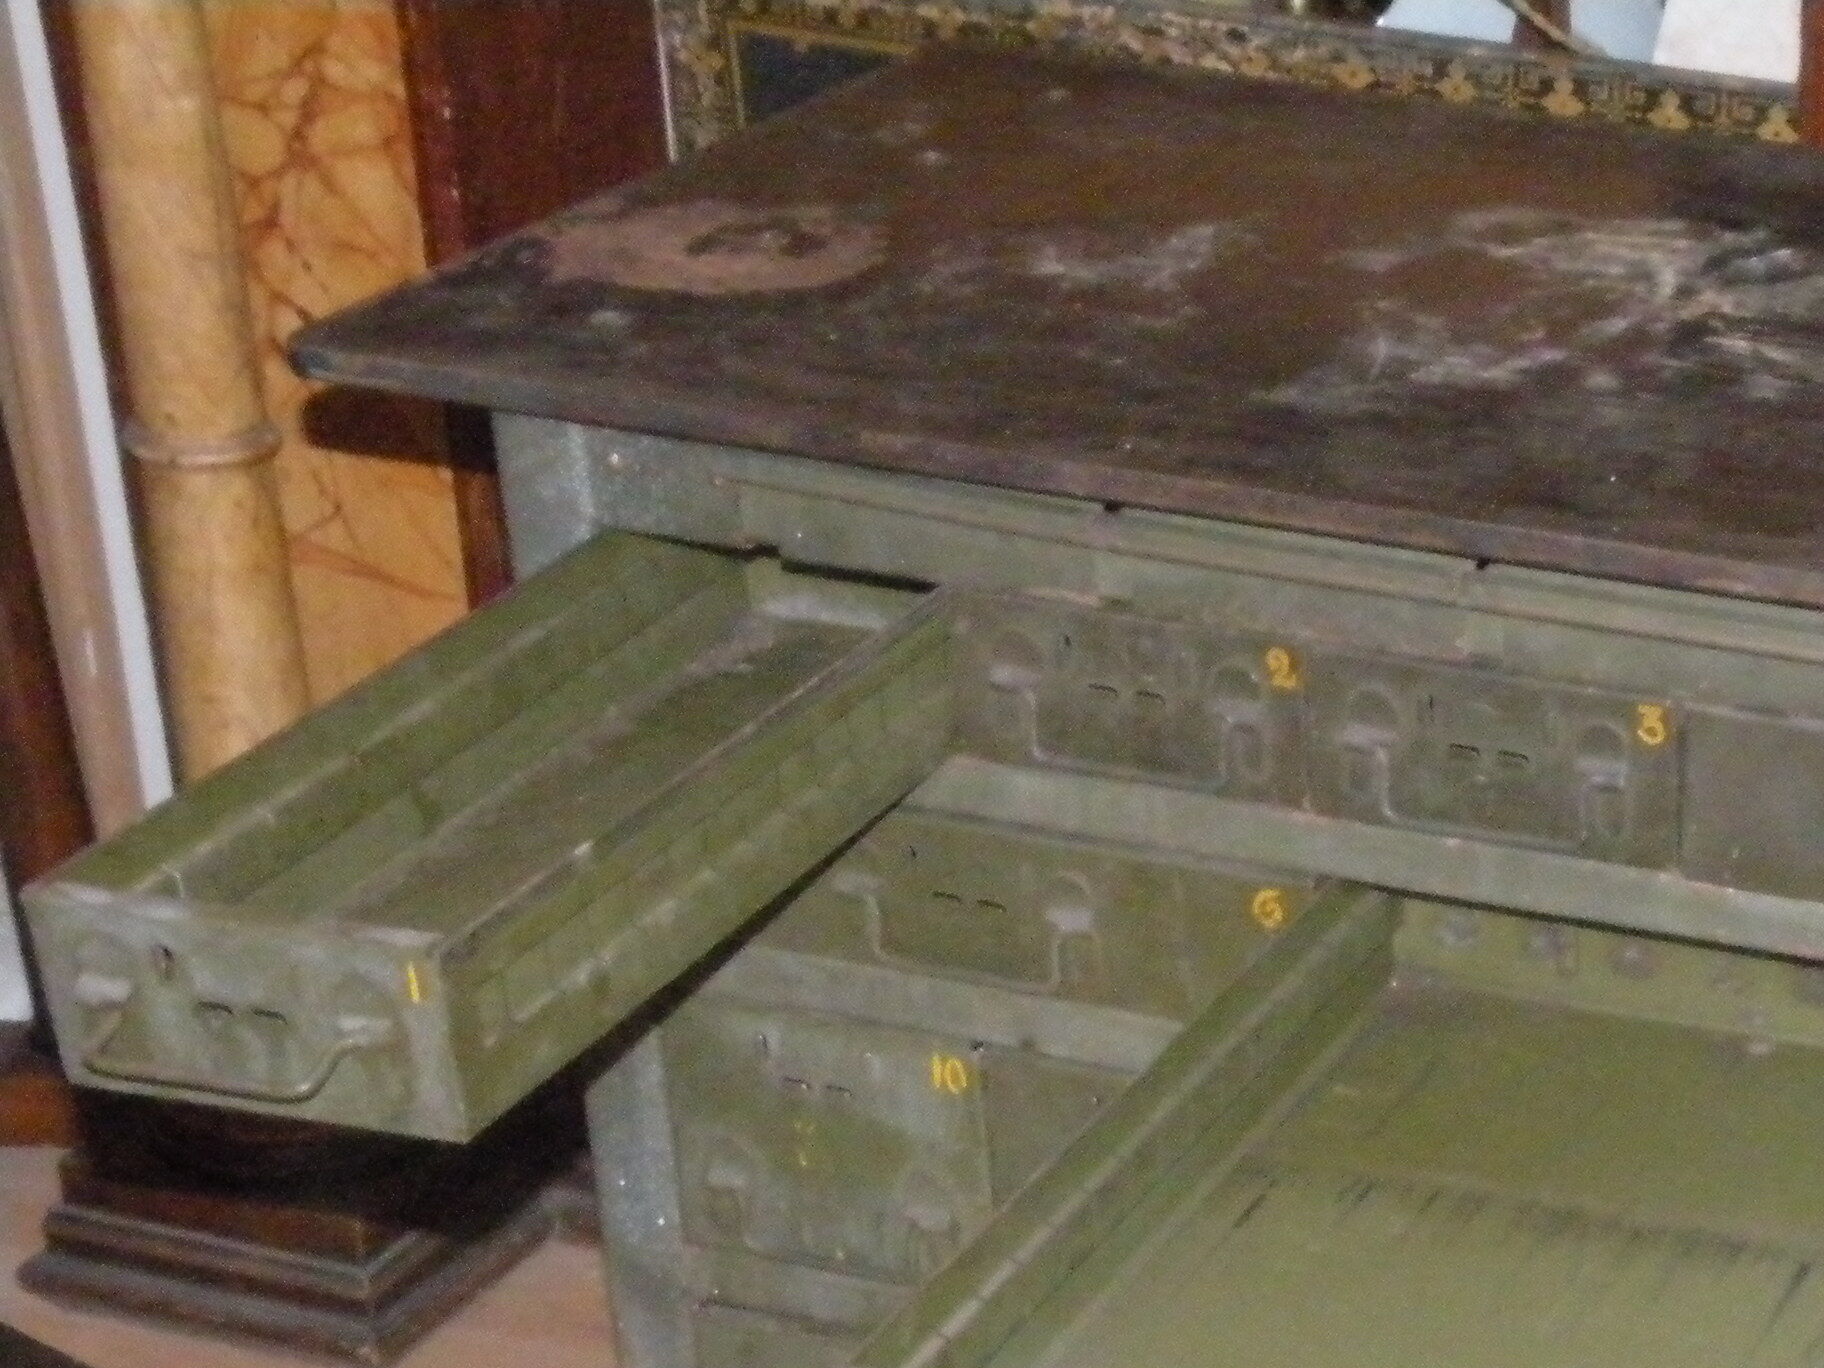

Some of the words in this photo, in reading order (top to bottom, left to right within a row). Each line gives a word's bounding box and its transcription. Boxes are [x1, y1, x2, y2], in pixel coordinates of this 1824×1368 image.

[1263, 647, 1303, 692] 2
[1636, 703, 1671, 747] 3
[1249, 889, 1291, 930] 6
[405, 960, 420, 1004] 1
[930, 1054, 978, 1096] 10
